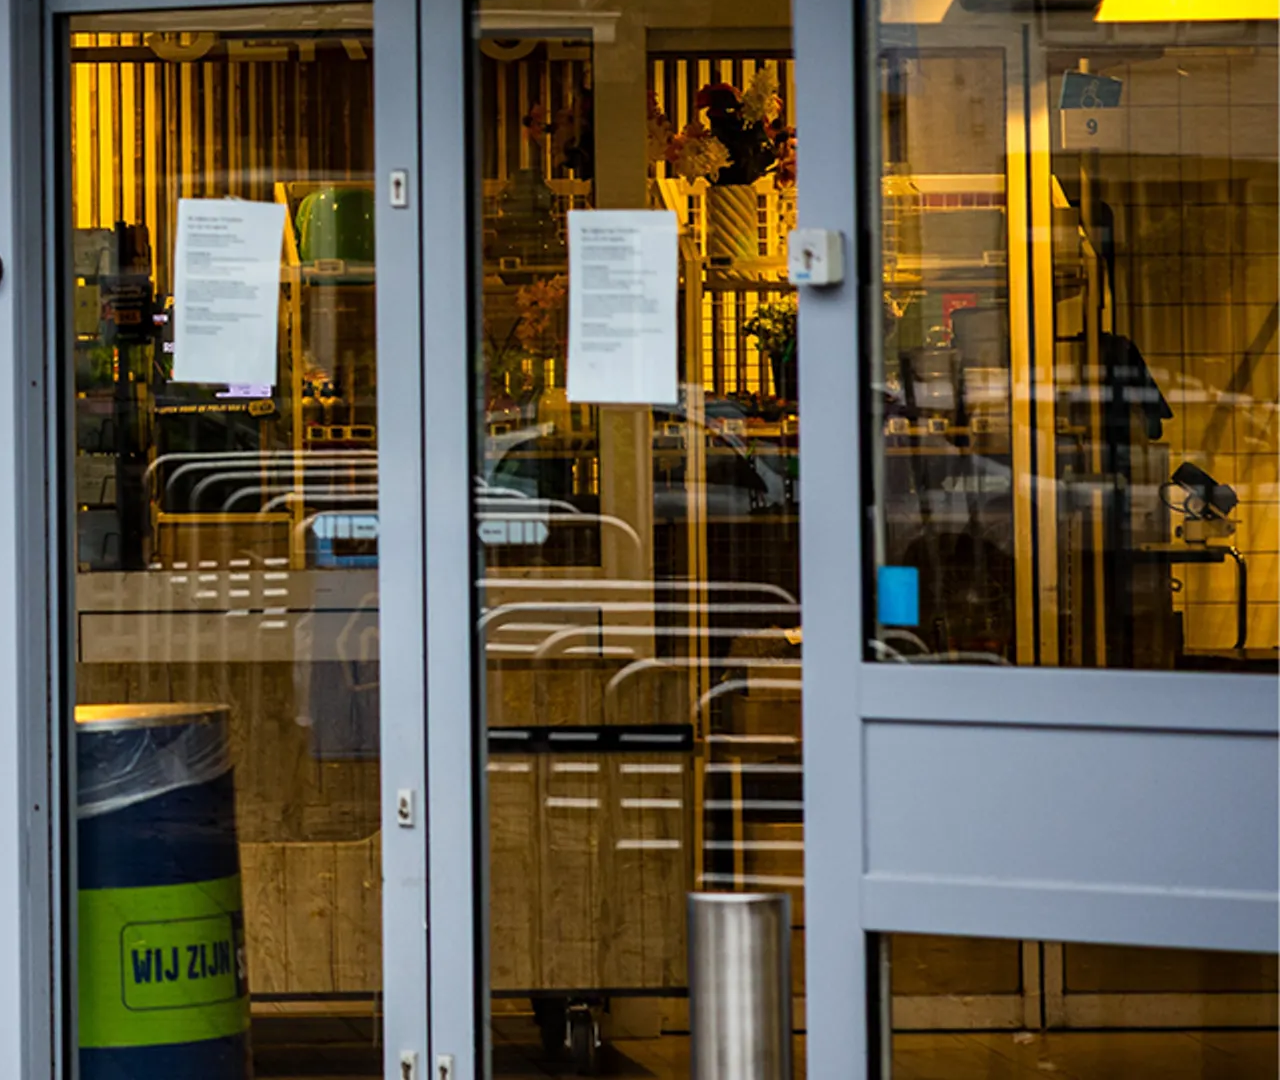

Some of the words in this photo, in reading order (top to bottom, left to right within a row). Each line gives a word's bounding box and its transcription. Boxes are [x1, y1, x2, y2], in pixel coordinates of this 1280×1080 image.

[1086, 119, 1098, 135] 9
[132, 947, 179, 984] WIJ
[187, 941, 231, 980] ZIJN
